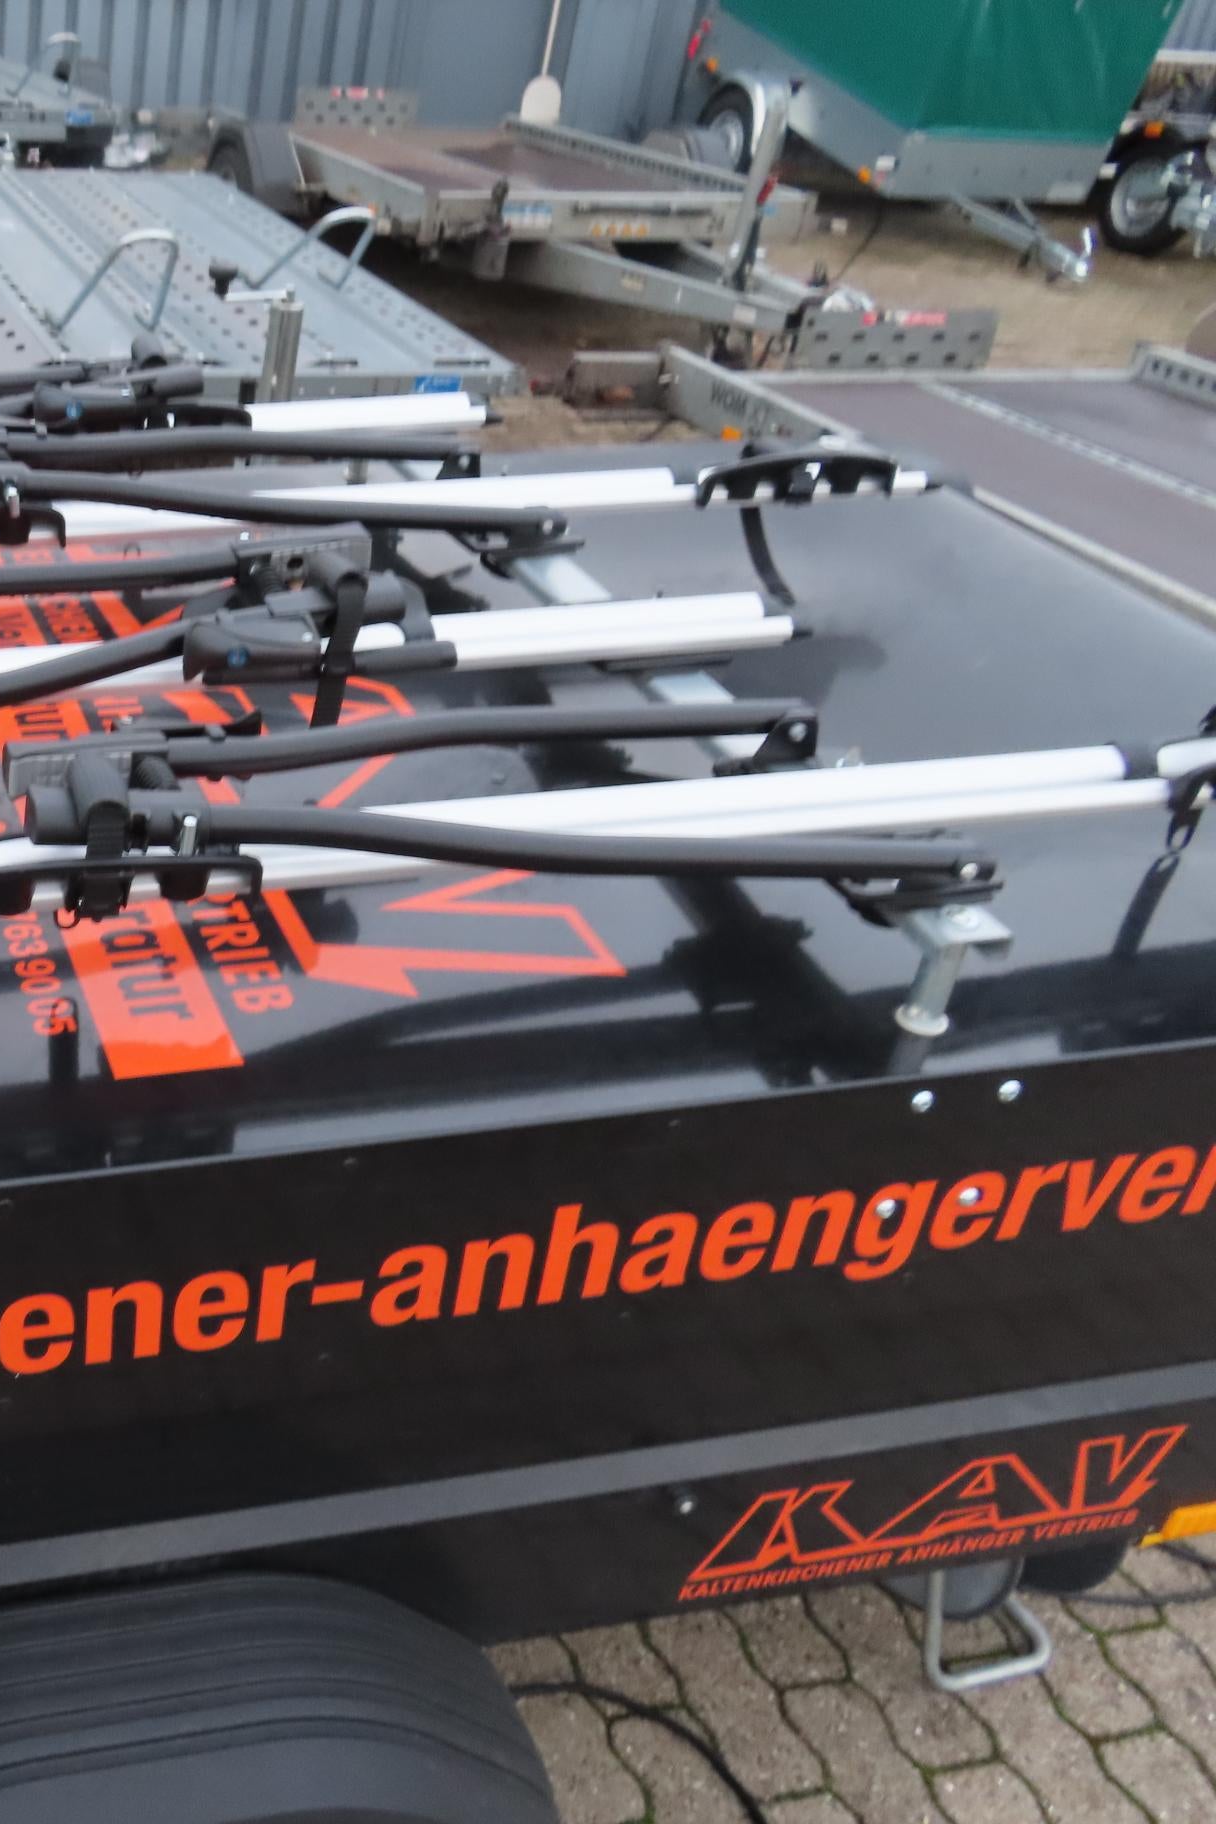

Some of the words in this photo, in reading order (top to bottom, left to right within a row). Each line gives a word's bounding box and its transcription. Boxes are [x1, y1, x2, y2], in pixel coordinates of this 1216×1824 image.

[679, 1554, 892, 1600] KALTENKIRCHENER
[1033, 1507, 1140, 1539] VERTRIEB
[687, 1424, 1189, 1582] KAV
